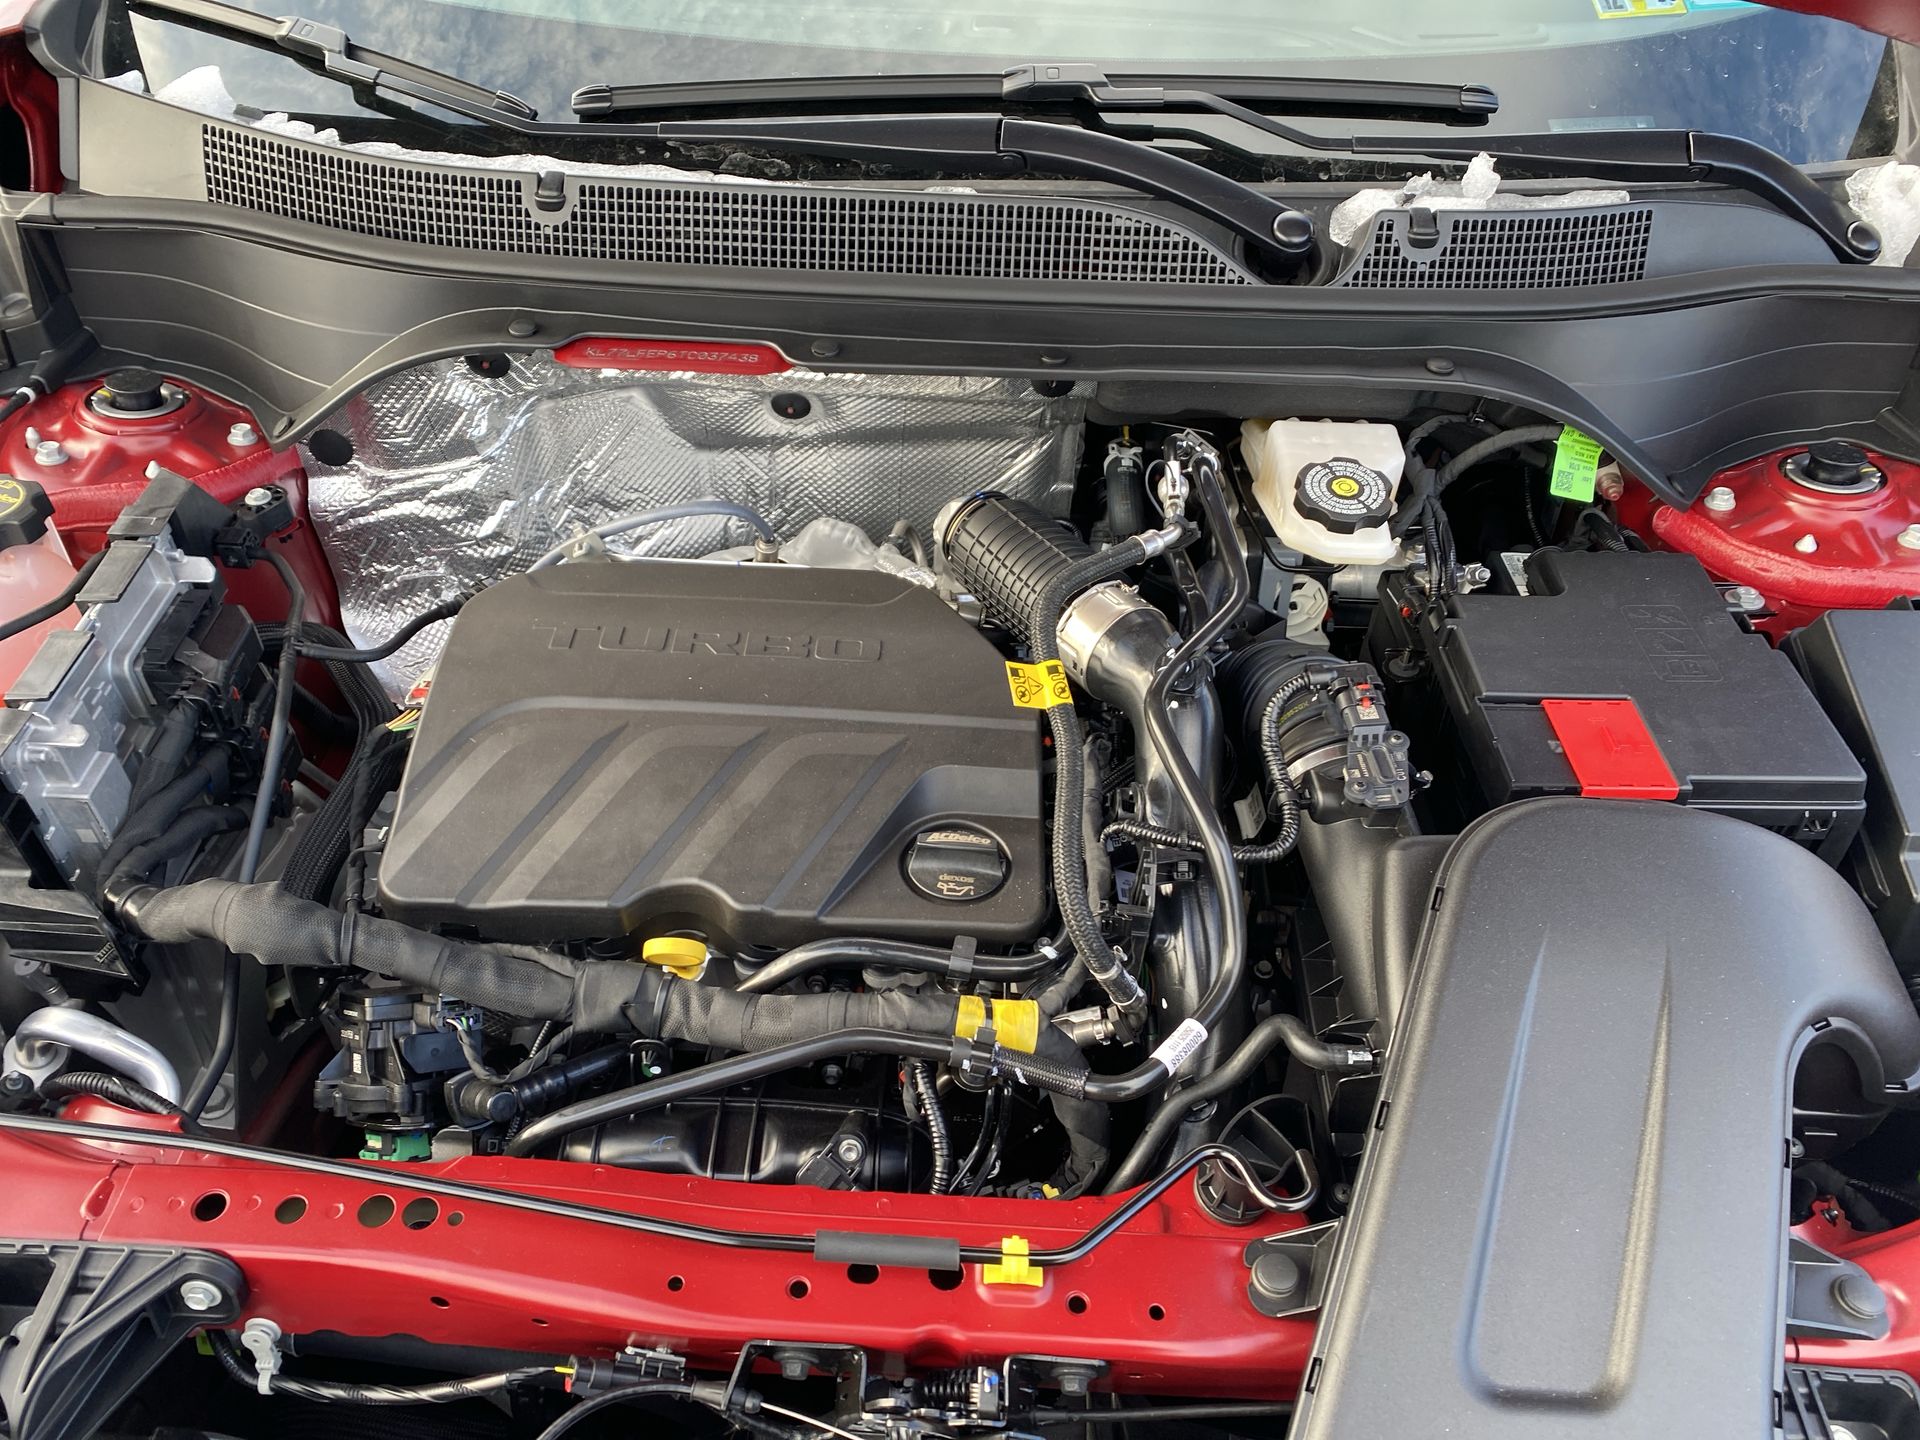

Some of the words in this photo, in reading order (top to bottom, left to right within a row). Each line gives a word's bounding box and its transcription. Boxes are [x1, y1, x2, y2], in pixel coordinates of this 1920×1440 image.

[531, 625, 884, 663] TURBO
[926, 832, 991, 844] ACDelco
[939, 873, 976, 883] dexos
